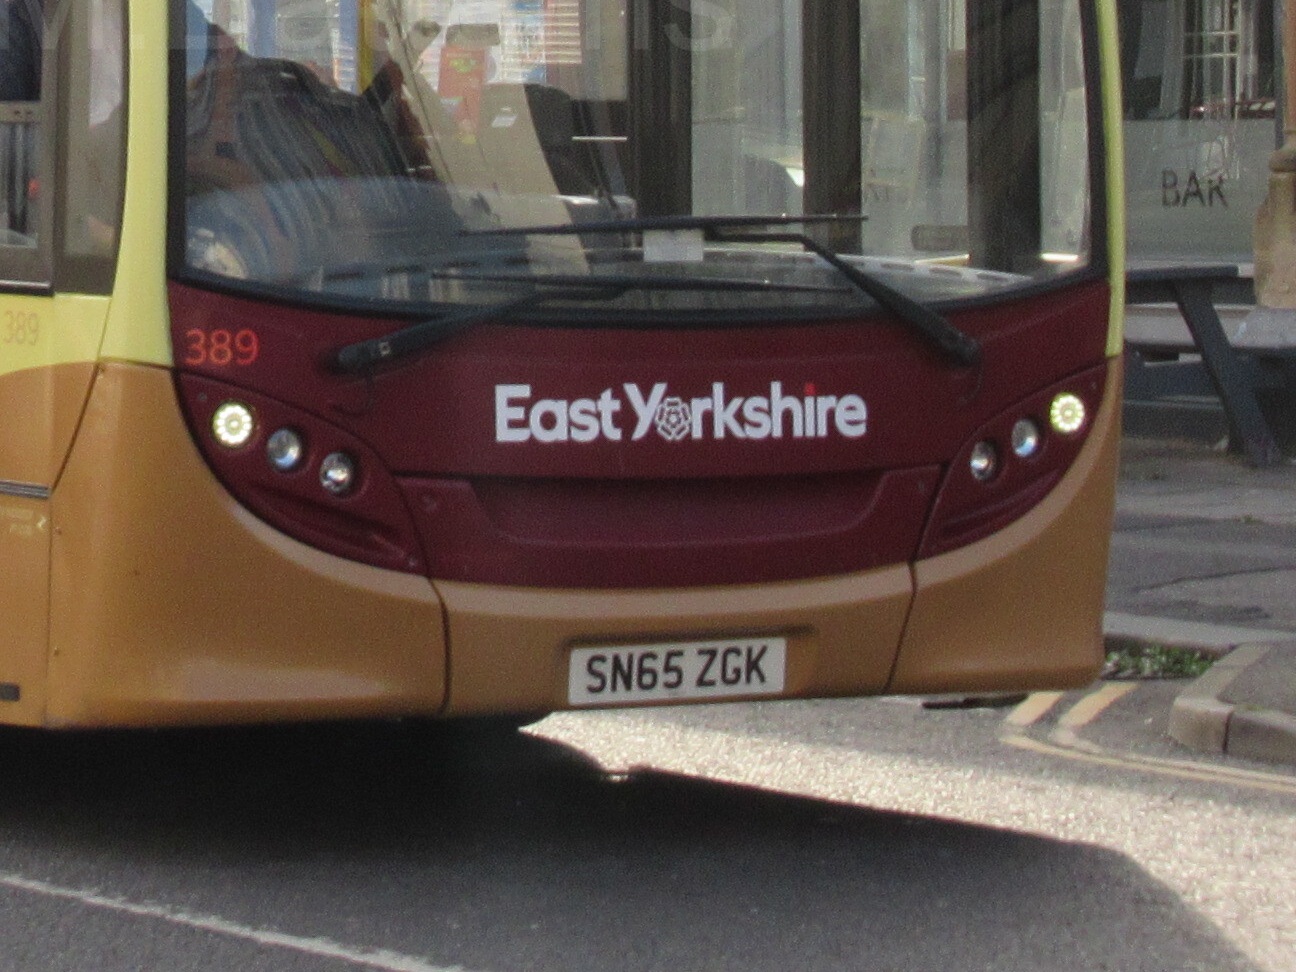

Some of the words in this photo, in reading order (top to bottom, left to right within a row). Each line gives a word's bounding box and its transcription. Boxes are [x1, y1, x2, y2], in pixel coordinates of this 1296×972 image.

[2, 311, 41, 347] 389
[183, 329, 260, 366] 389
[494, 383, 624, 443] East
[622, 381, 868, 442] Yorkshire
[584, 648, 685, 696] SN65
[694, 644, 769, 690] ZGK
